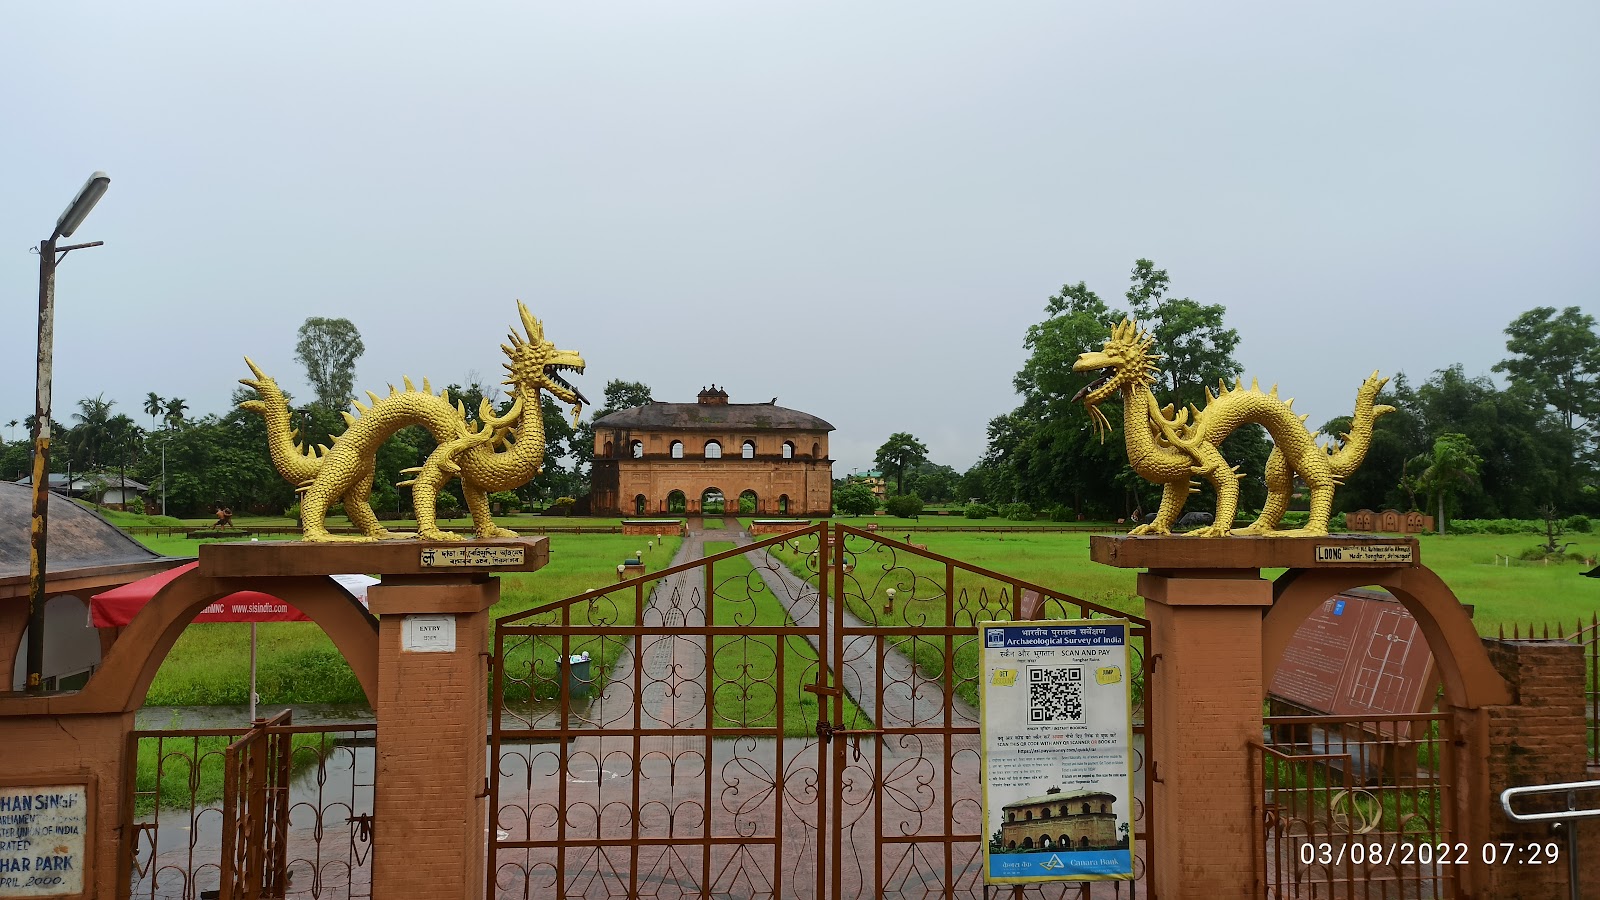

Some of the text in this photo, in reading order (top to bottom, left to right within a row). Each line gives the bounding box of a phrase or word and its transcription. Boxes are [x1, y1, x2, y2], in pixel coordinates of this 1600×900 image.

[1318, 546, 1342, 560] LOONG
[232, 602, 288, 613] www.sisindia.com
[1021, 627, 1048, 636] भारतीय
[1006, 636, 1122, 646] Archaeological Survey of India
[55, 825, 79, 835] INDIA
[35, 855, 73, 871] PARK
[1070, 859, 1098, 867] Canara
